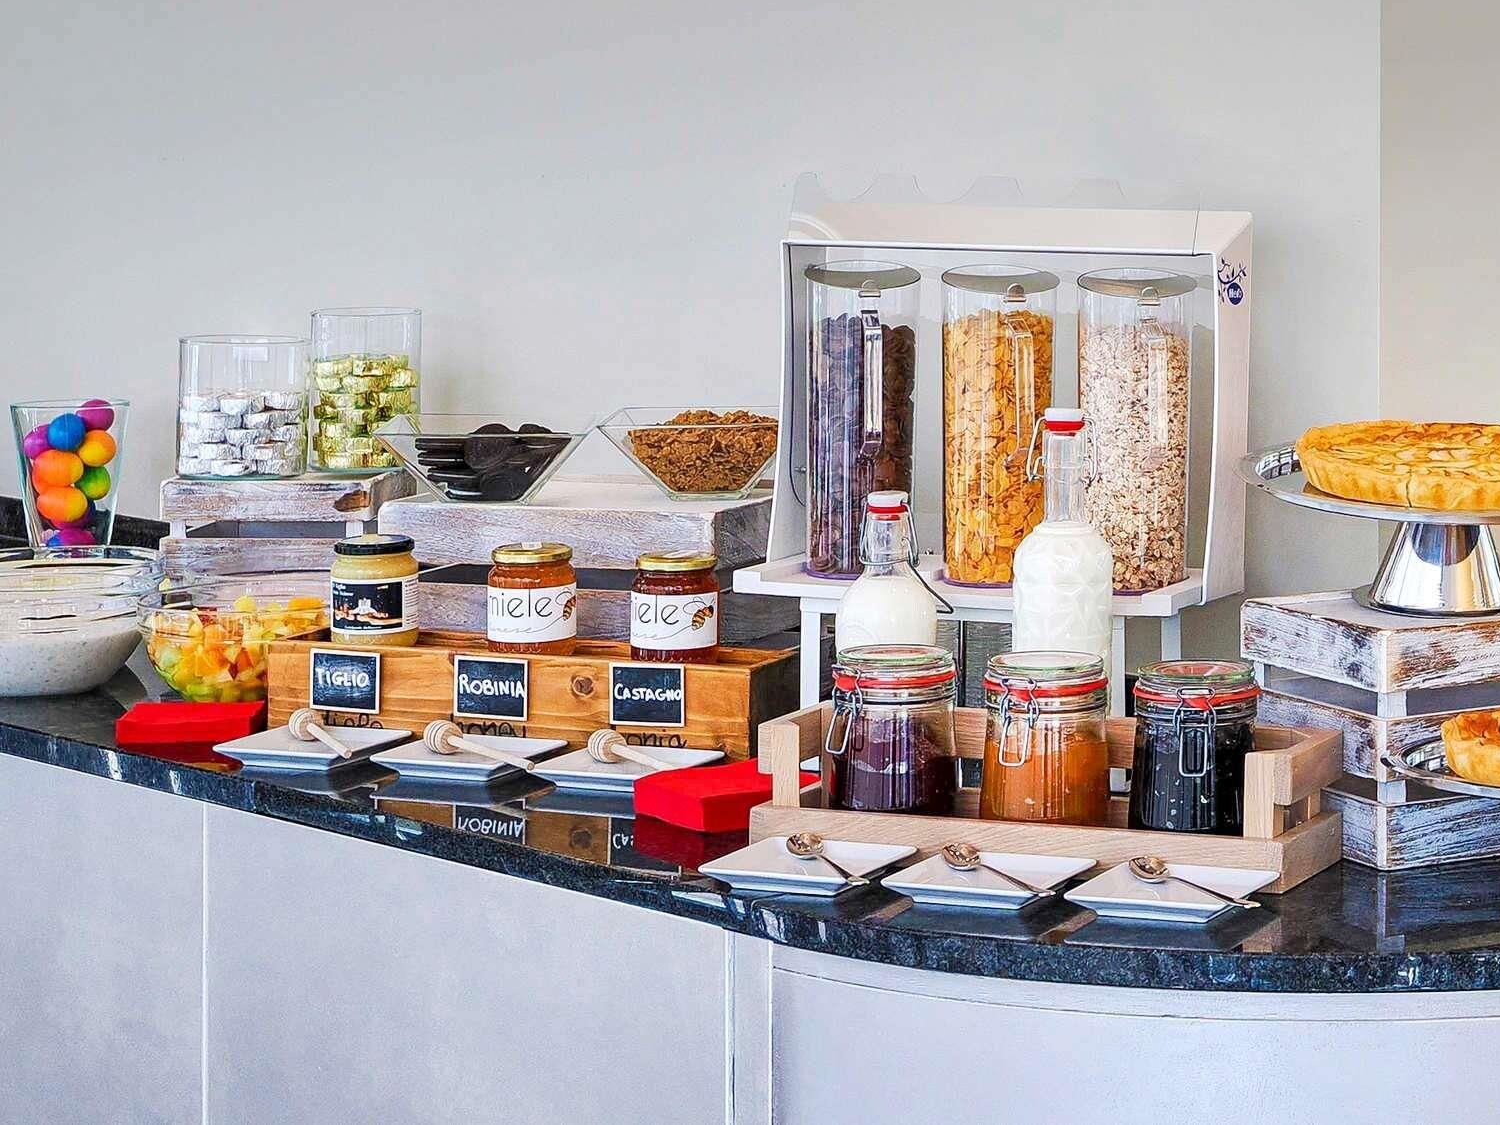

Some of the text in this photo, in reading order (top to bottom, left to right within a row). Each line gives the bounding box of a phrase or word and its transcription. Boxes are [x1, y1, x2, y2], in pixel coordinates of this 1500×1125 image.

[315, 667, 370, 688] TIGLIO
[458, 673, 525, 699] ROBINIA
[614, 682, 682, 702] CASTAGNO
